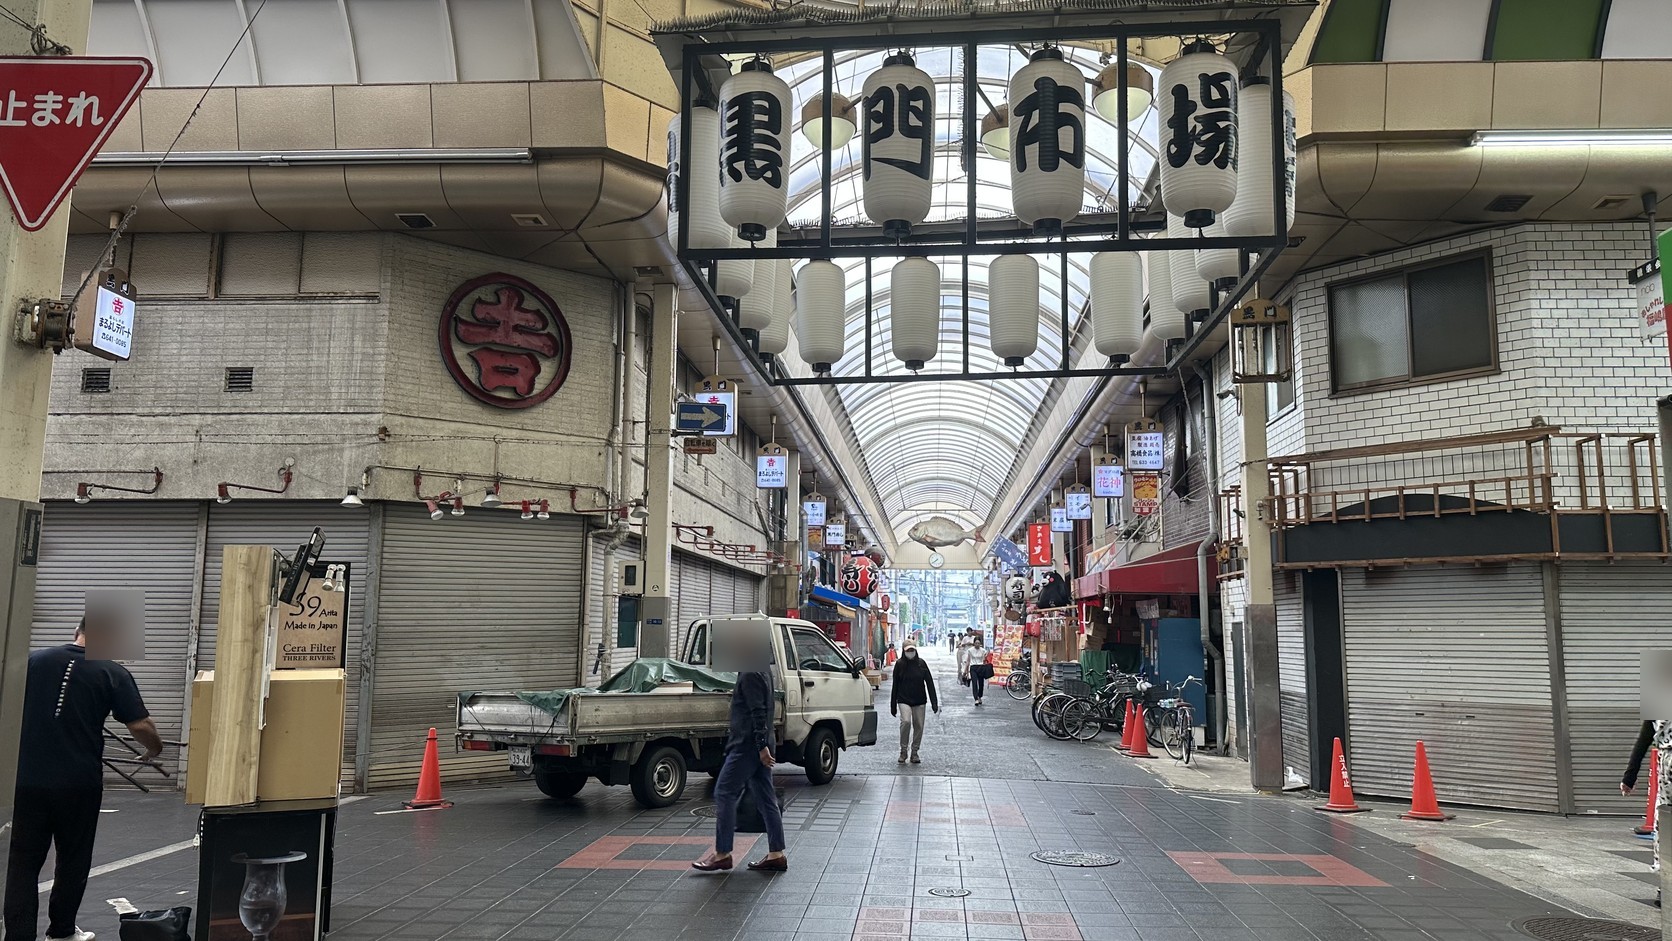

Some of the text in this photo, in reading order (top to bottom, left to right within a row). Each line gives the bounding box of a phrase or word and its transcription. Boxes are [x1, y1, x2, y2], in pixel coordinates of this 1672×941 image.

[0, 89, 104, 128] 止まれ
[719, 71, 1239, 189] 黒門市場
[106, 273, 130, 295] 黒門
[1242, 306, 1277, 320] 黒門
[99, 317, 132, 338] まるよしデパート
[1011, 579, 1025, 599] 寿司
[319, 609, 338, 617] Arita
[284, 621, 338, 630] Made in Japan
[283, 643, 337, 652] Cera Filter
[1338, 754, 1351, 788] 立入禁止
